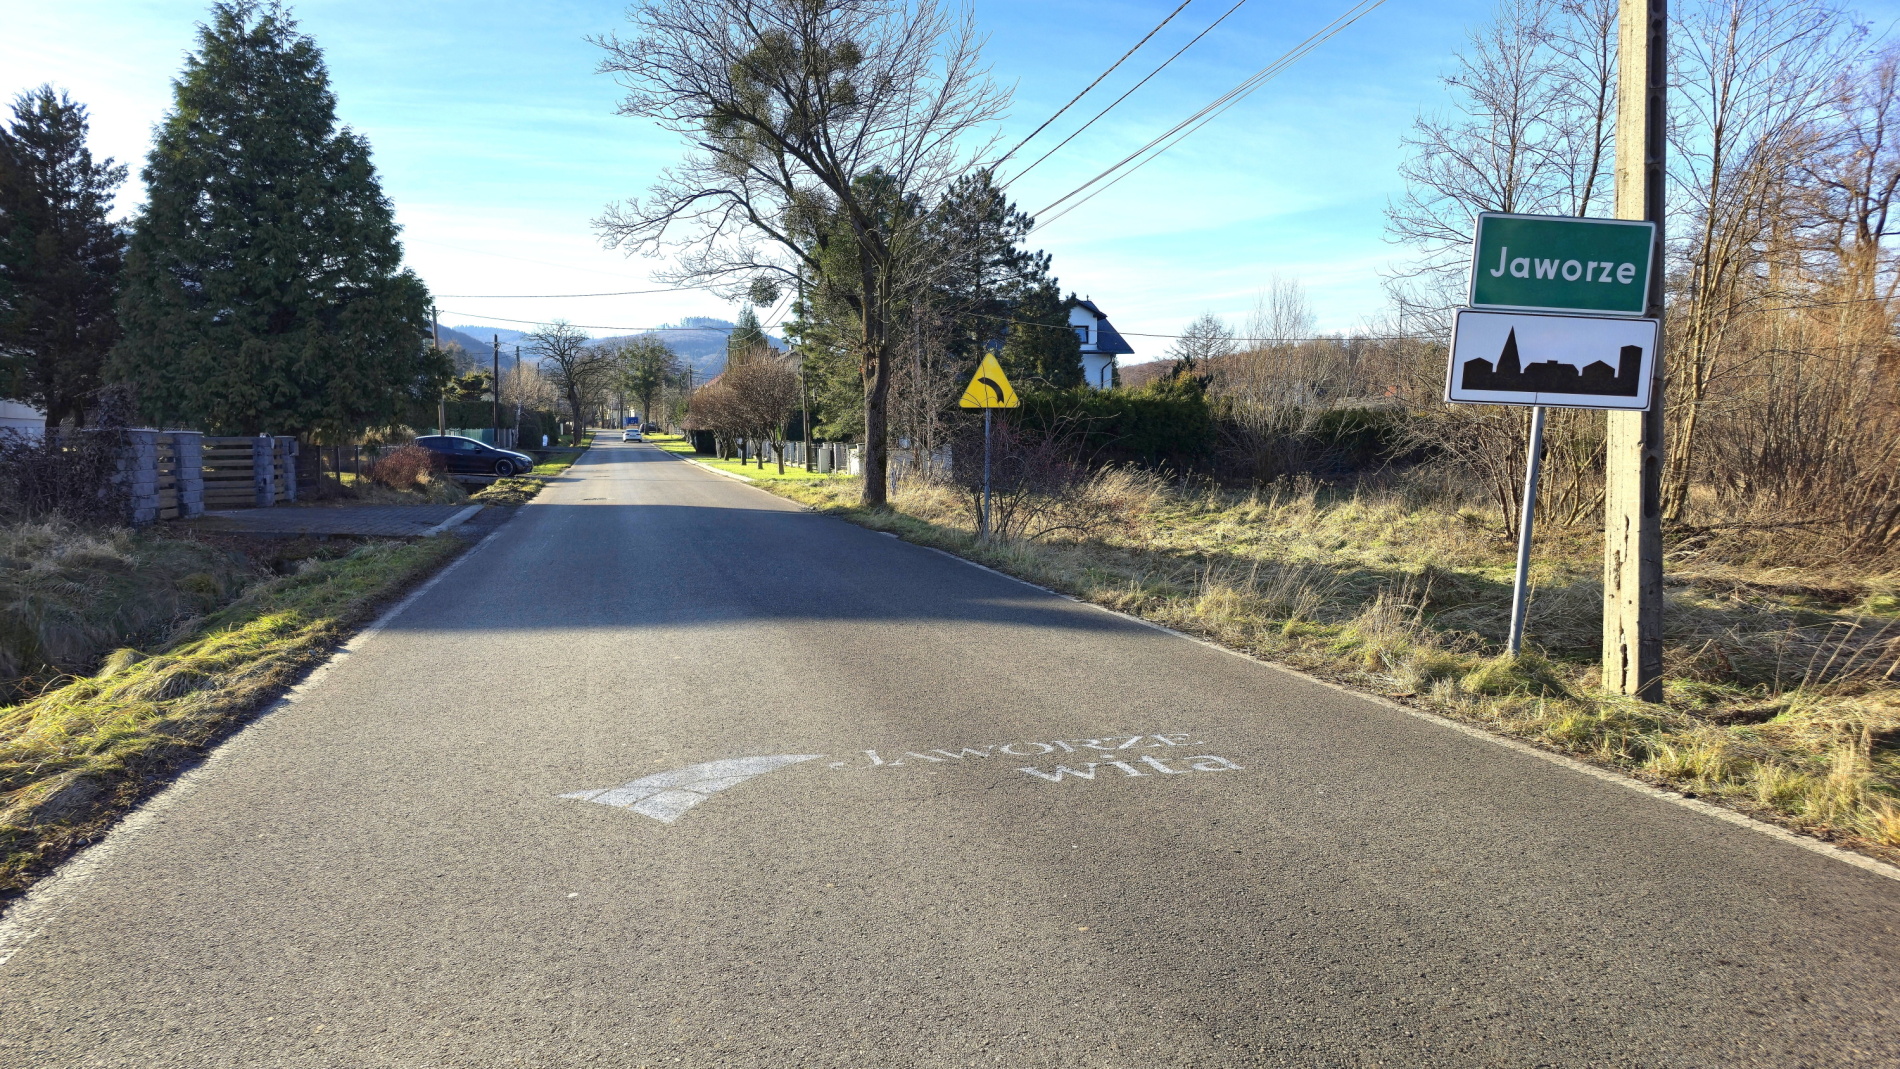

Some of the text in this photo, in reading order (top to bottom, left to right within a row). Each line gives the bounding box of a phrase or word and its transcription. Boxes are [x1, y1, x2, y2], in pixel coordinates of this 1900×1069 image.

[1489, 246, 1636, 285] Jaworze
[829, 733, 1204, 768] JAWORZE
[1016, 754, 1245, 782] wita
